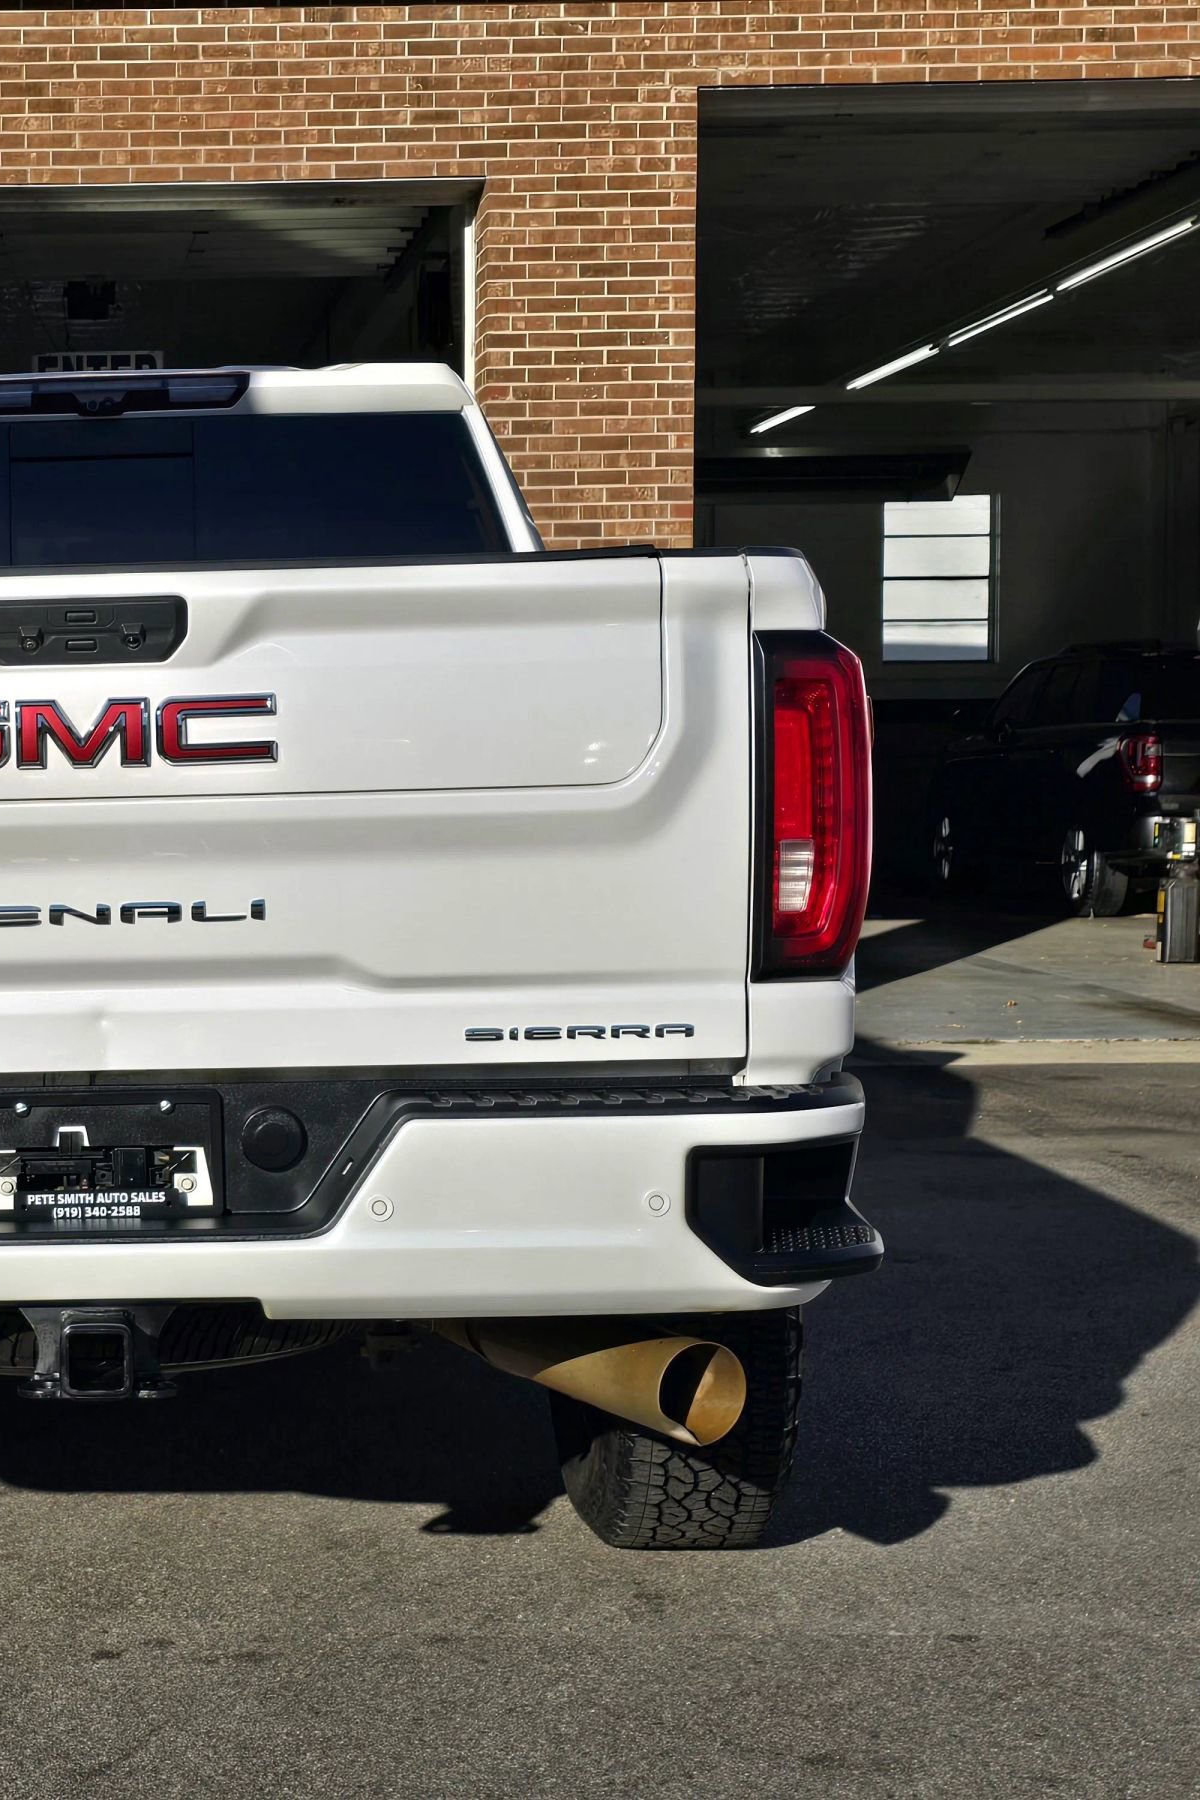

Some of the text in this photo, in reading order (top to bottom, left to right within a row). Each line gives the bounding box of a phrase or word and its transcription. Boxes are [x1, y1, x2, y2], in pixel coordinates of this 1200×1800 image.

[464, 1023, 695, 1042] SIERRA
[27, 1191, 166, 1205] PETE SMITH AUTO SALES
[53, 1205, 141, 1219] (919) 340-2588
